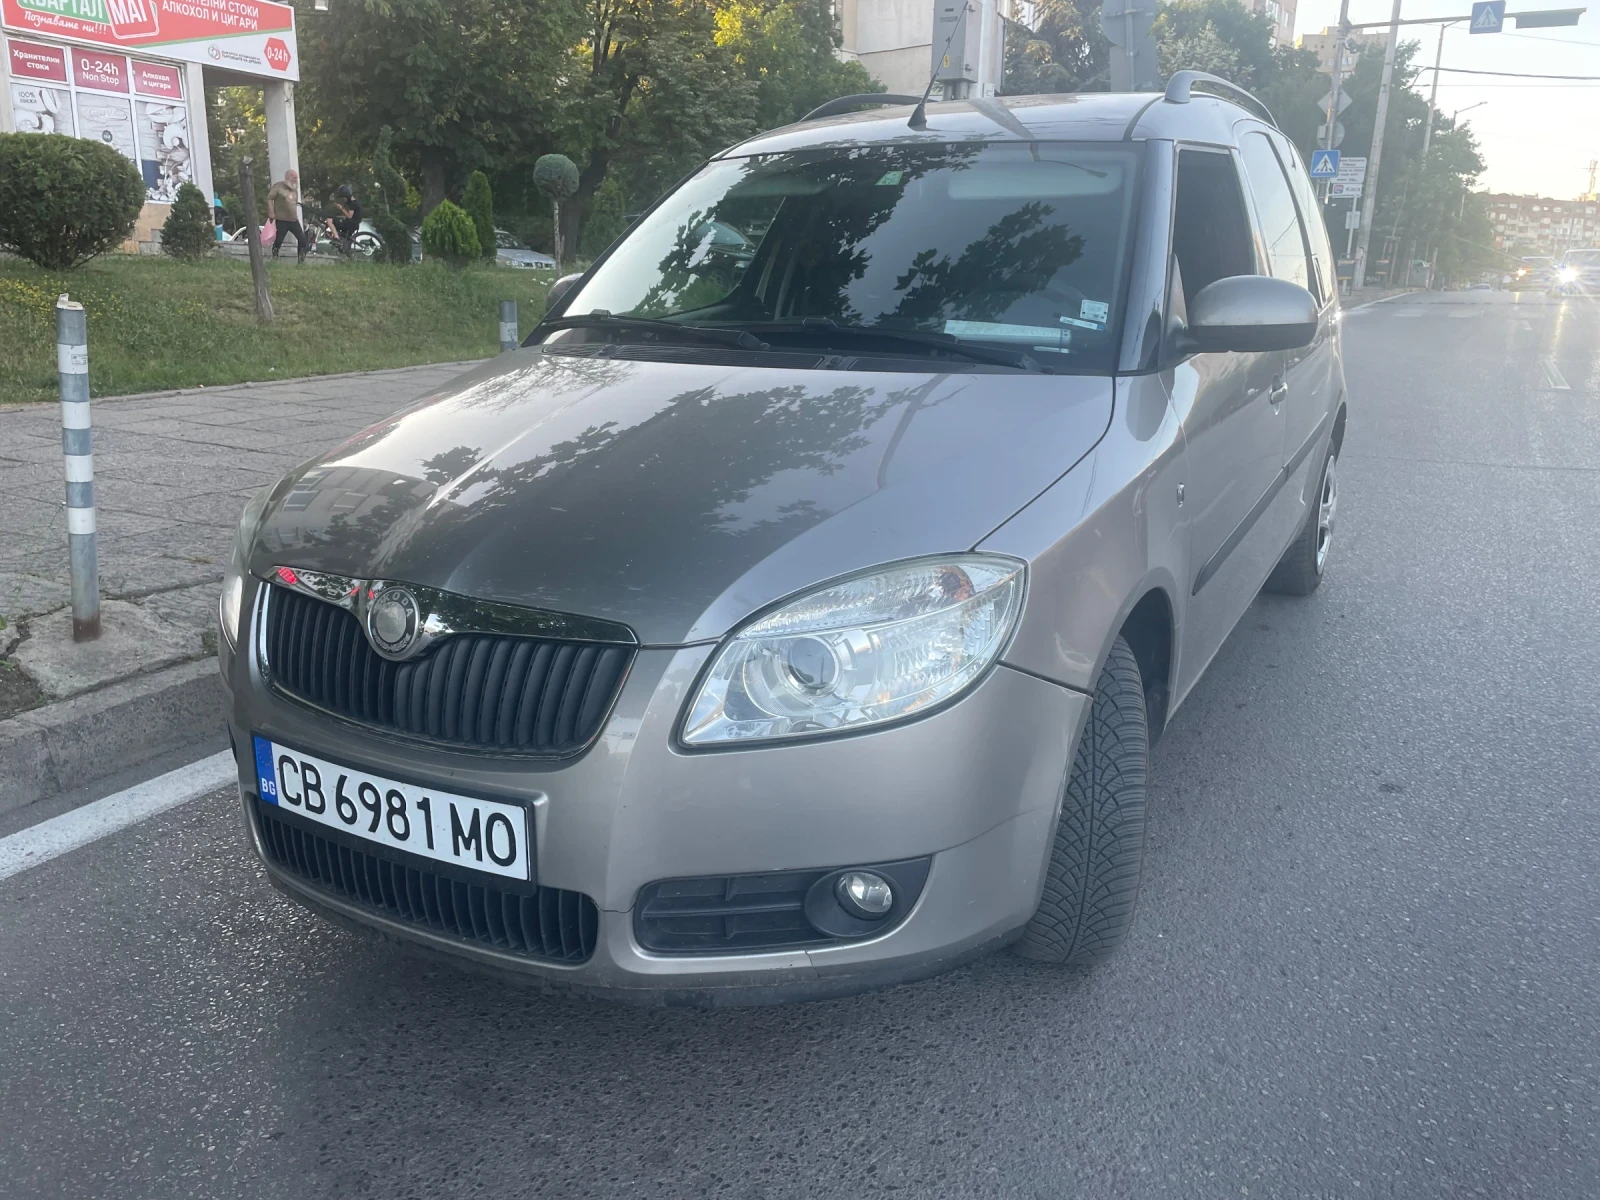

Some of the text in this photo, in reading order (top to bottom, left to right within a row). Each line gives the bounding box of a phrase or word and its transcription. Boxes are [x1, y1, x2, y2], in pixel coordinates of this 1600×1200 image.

[22, 0, 103, 19] АРТАЛ
[162, 1, 258, 30] АЛКОХОЛ И ЦИГАРИ
[228, 2, 259, 18] СТОКИ
[24, 11, 107, 35] Познавате ни!!!
[13, 49, 60, 64] Хранителни
[27, 61, 50, 71] стоки
[81, 58, 119, 76] 0-24h
[83, 72, 120, 86] Non Stop
[142, 70, 170, 82] Алкохол
[148, 81, 172, 90] цигари
[261, 778, 276, 796] BG
[278, 754, 517, 867] CB 6981 MO
